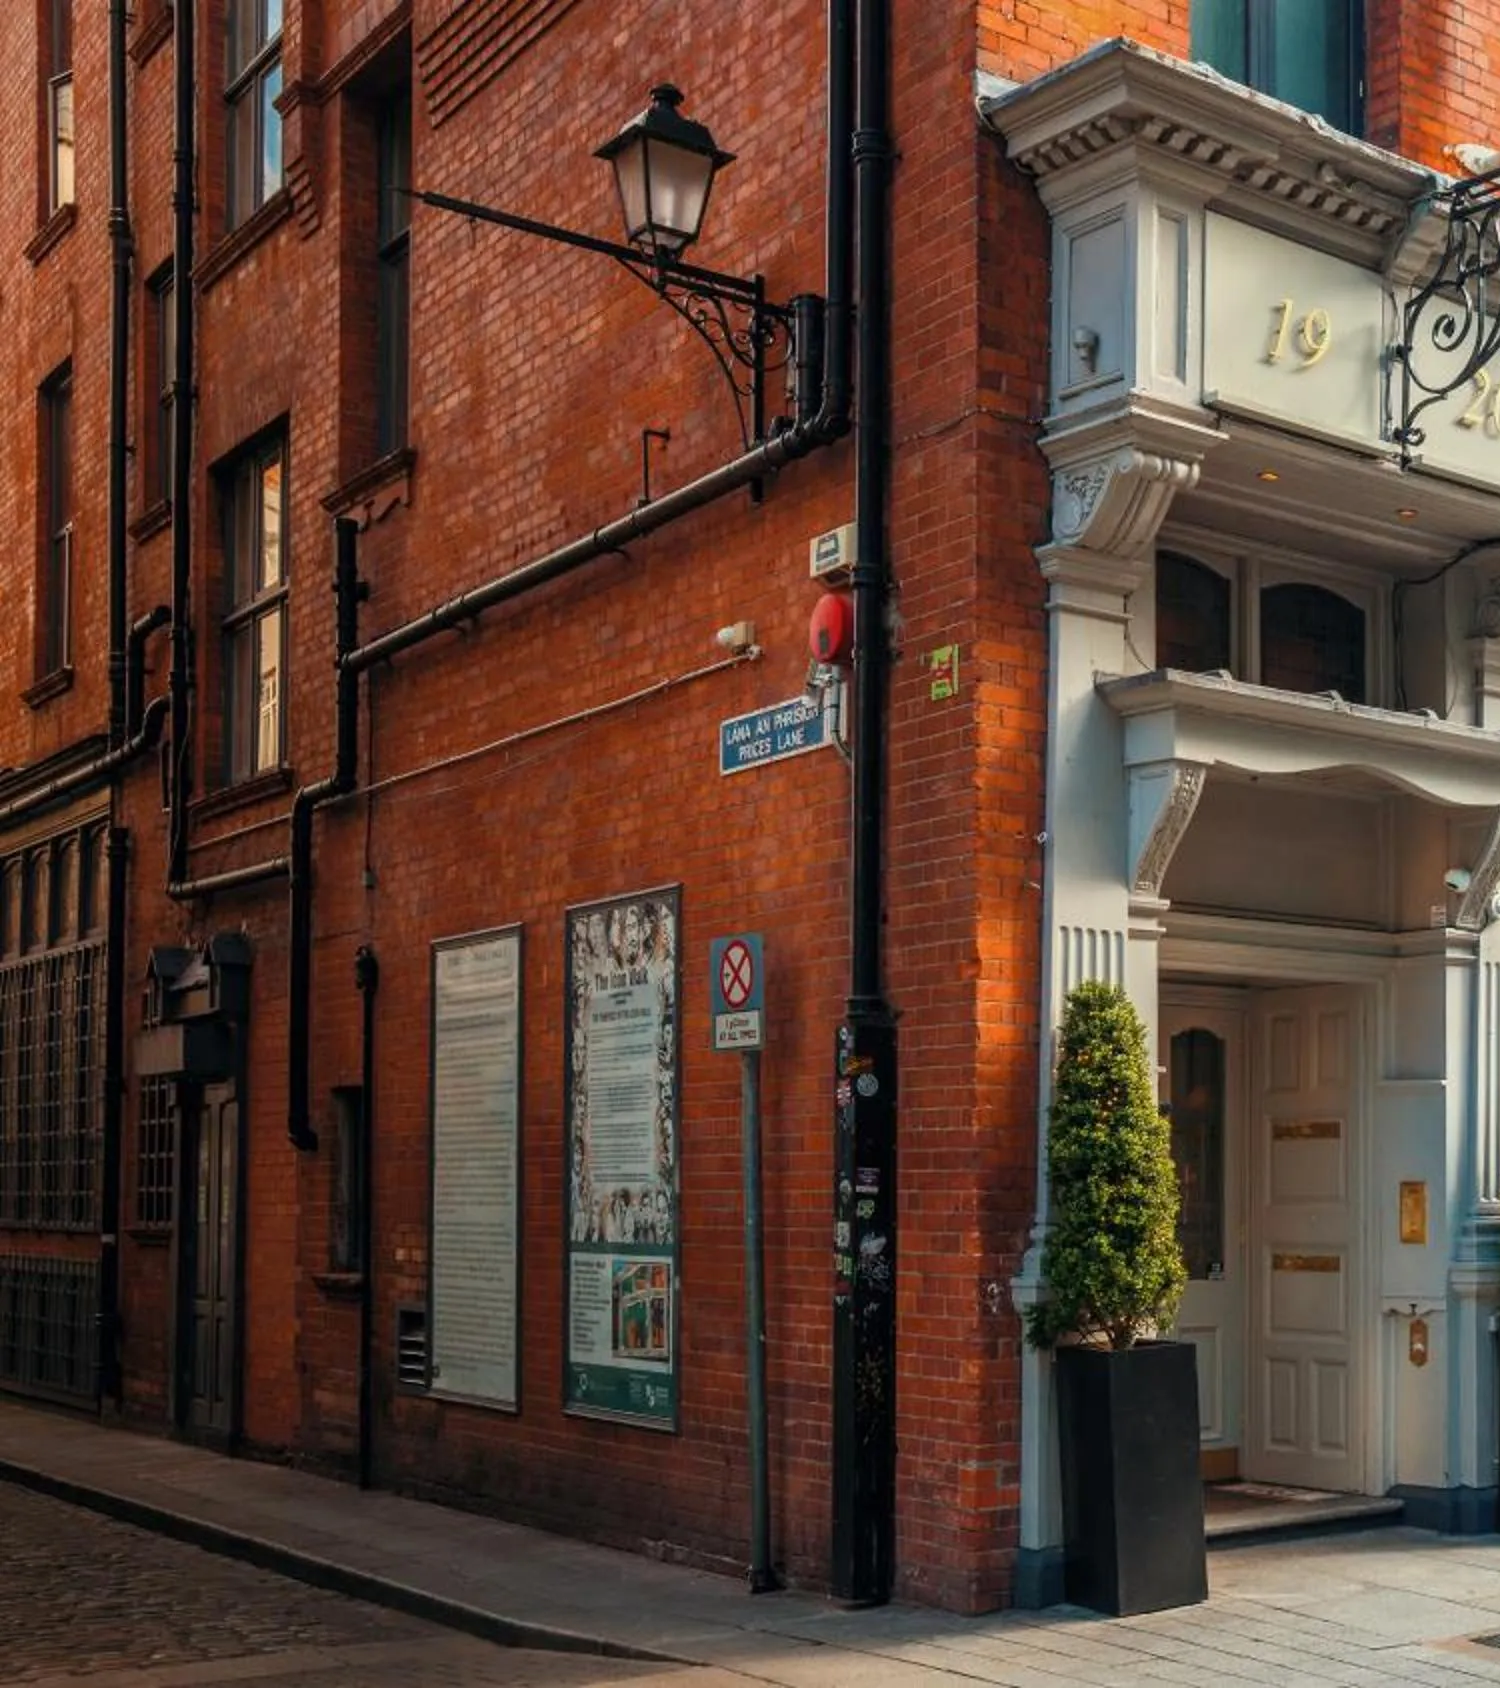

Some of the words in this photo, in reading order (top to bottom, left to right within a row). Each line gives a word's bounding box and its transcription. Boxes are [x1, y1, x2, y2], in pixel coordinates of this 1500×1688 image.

[1269, 298, 1332, 368] 19
[726, 722, 751, 746] LÁNA
[755, 716, 771, 735] AN
[739, 737, 772, 761] PRICES
[777, 727, 805, 751] LANE
